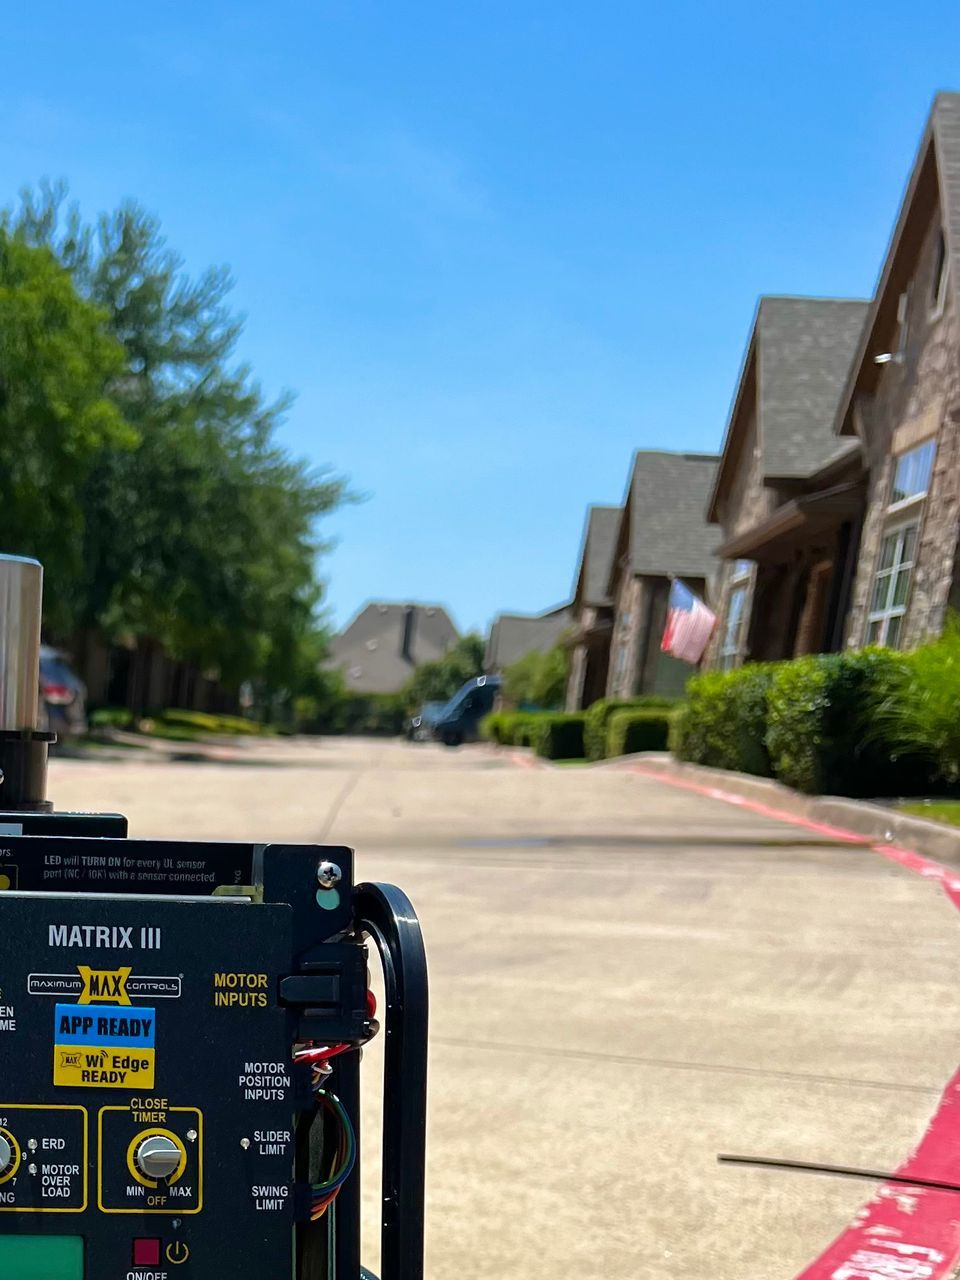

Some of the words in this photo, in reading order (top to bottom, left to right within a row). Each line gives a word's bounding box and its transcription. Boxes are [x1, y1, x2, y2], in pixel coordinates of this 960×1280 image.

[48, 925, 133, 948] MATRIX
[141, 927, 161, 949] III
[214, 974, 268, 987] MOTOR
[215, 993, 267, 1006] INPUTS
[60, 1016, 93, 1034] APP
[98, 1018, 151, 1037] READY
[113, 1056, 149, 1072] Edge
[245, 1063, 285, 1073] MOTOR
[82, 1071, 127, 1083] READY
[239, 1076, 290, 1087] POSITION
[244, 1089, 285, 1100] INPUTS
[131, 1098, 168, 1110] CLOSE
[132, 1112, 166, 1122] TIMER
[254, 1131, 291, 1142] SLIDER
[259, 1145, 285, 1154] LIMIT
